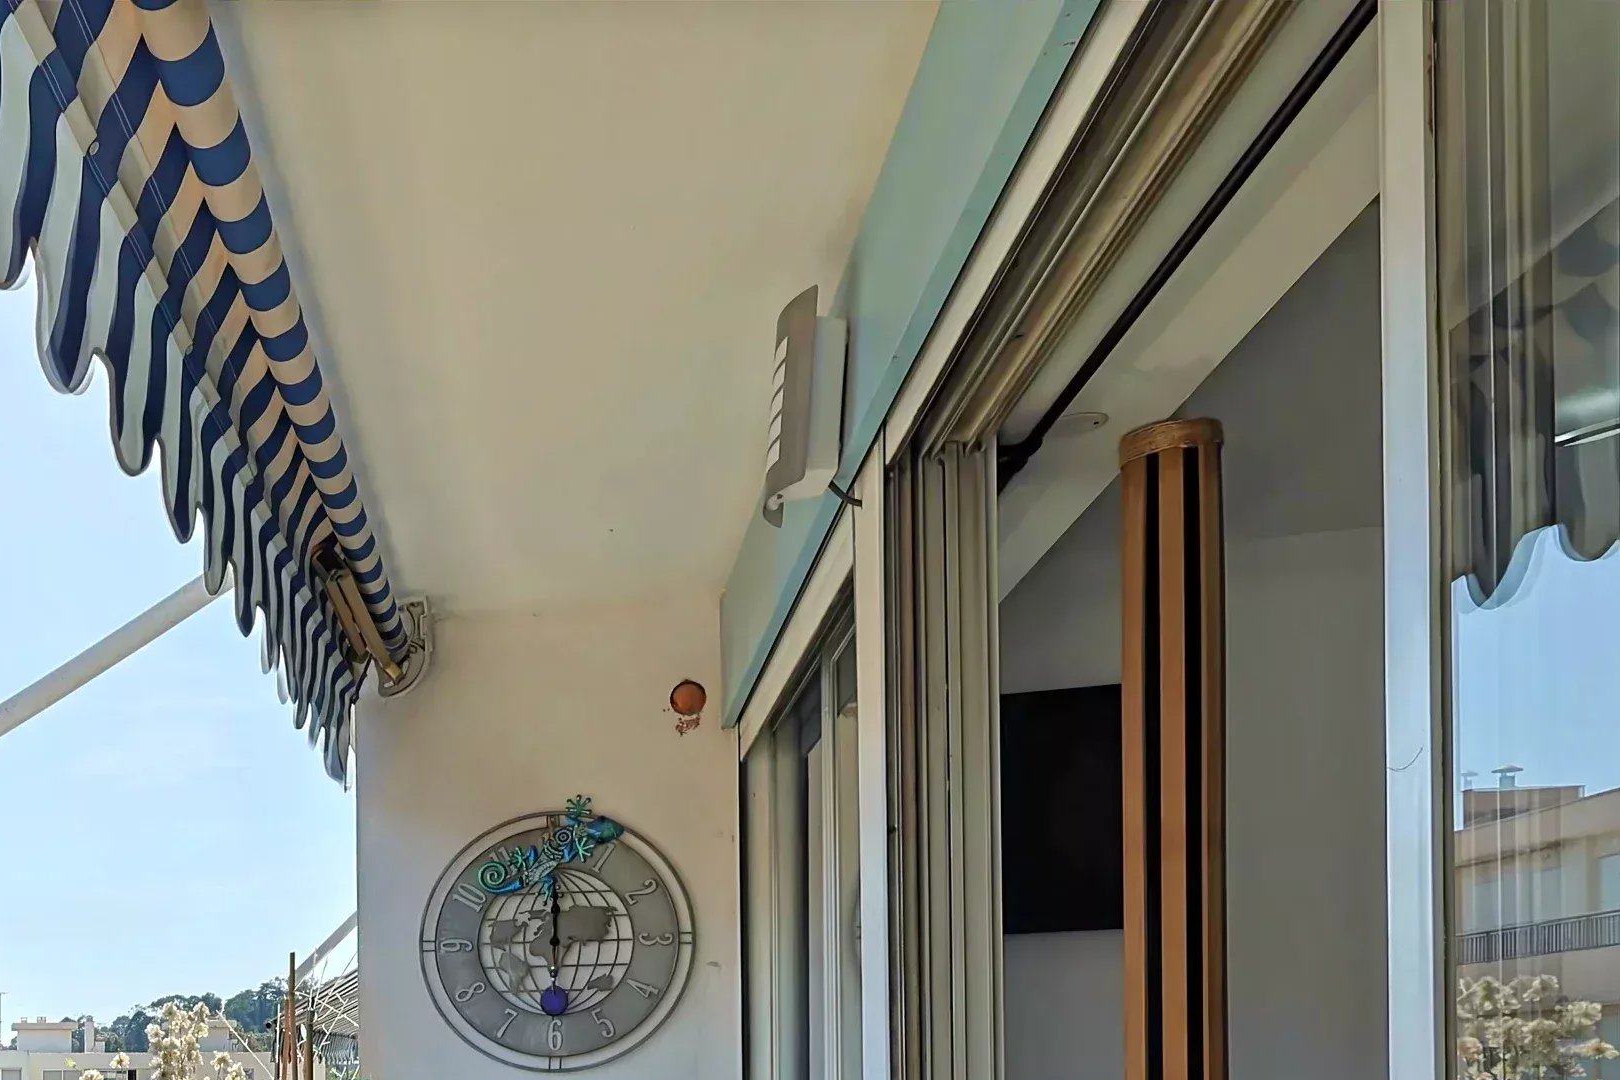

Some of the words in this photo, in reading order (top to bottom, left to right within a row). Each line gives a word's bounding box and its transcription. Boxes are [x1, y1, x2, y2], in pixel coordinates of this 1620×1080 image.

[591, 842, 616, 874] 1
[452, 883, 487, 913] 10
[625, 878, 658, 905] 2
[440, 937, 473, 953] 9
[638, 931, 674, 948] 3
[455, 981, 486, 1003] 8
[626, 977, 660, 999] 4
[496, 1008, 519, 1039] 7
[546, 1018, 564, 1051] 6
[590, 1008, 616, 1038] 5
